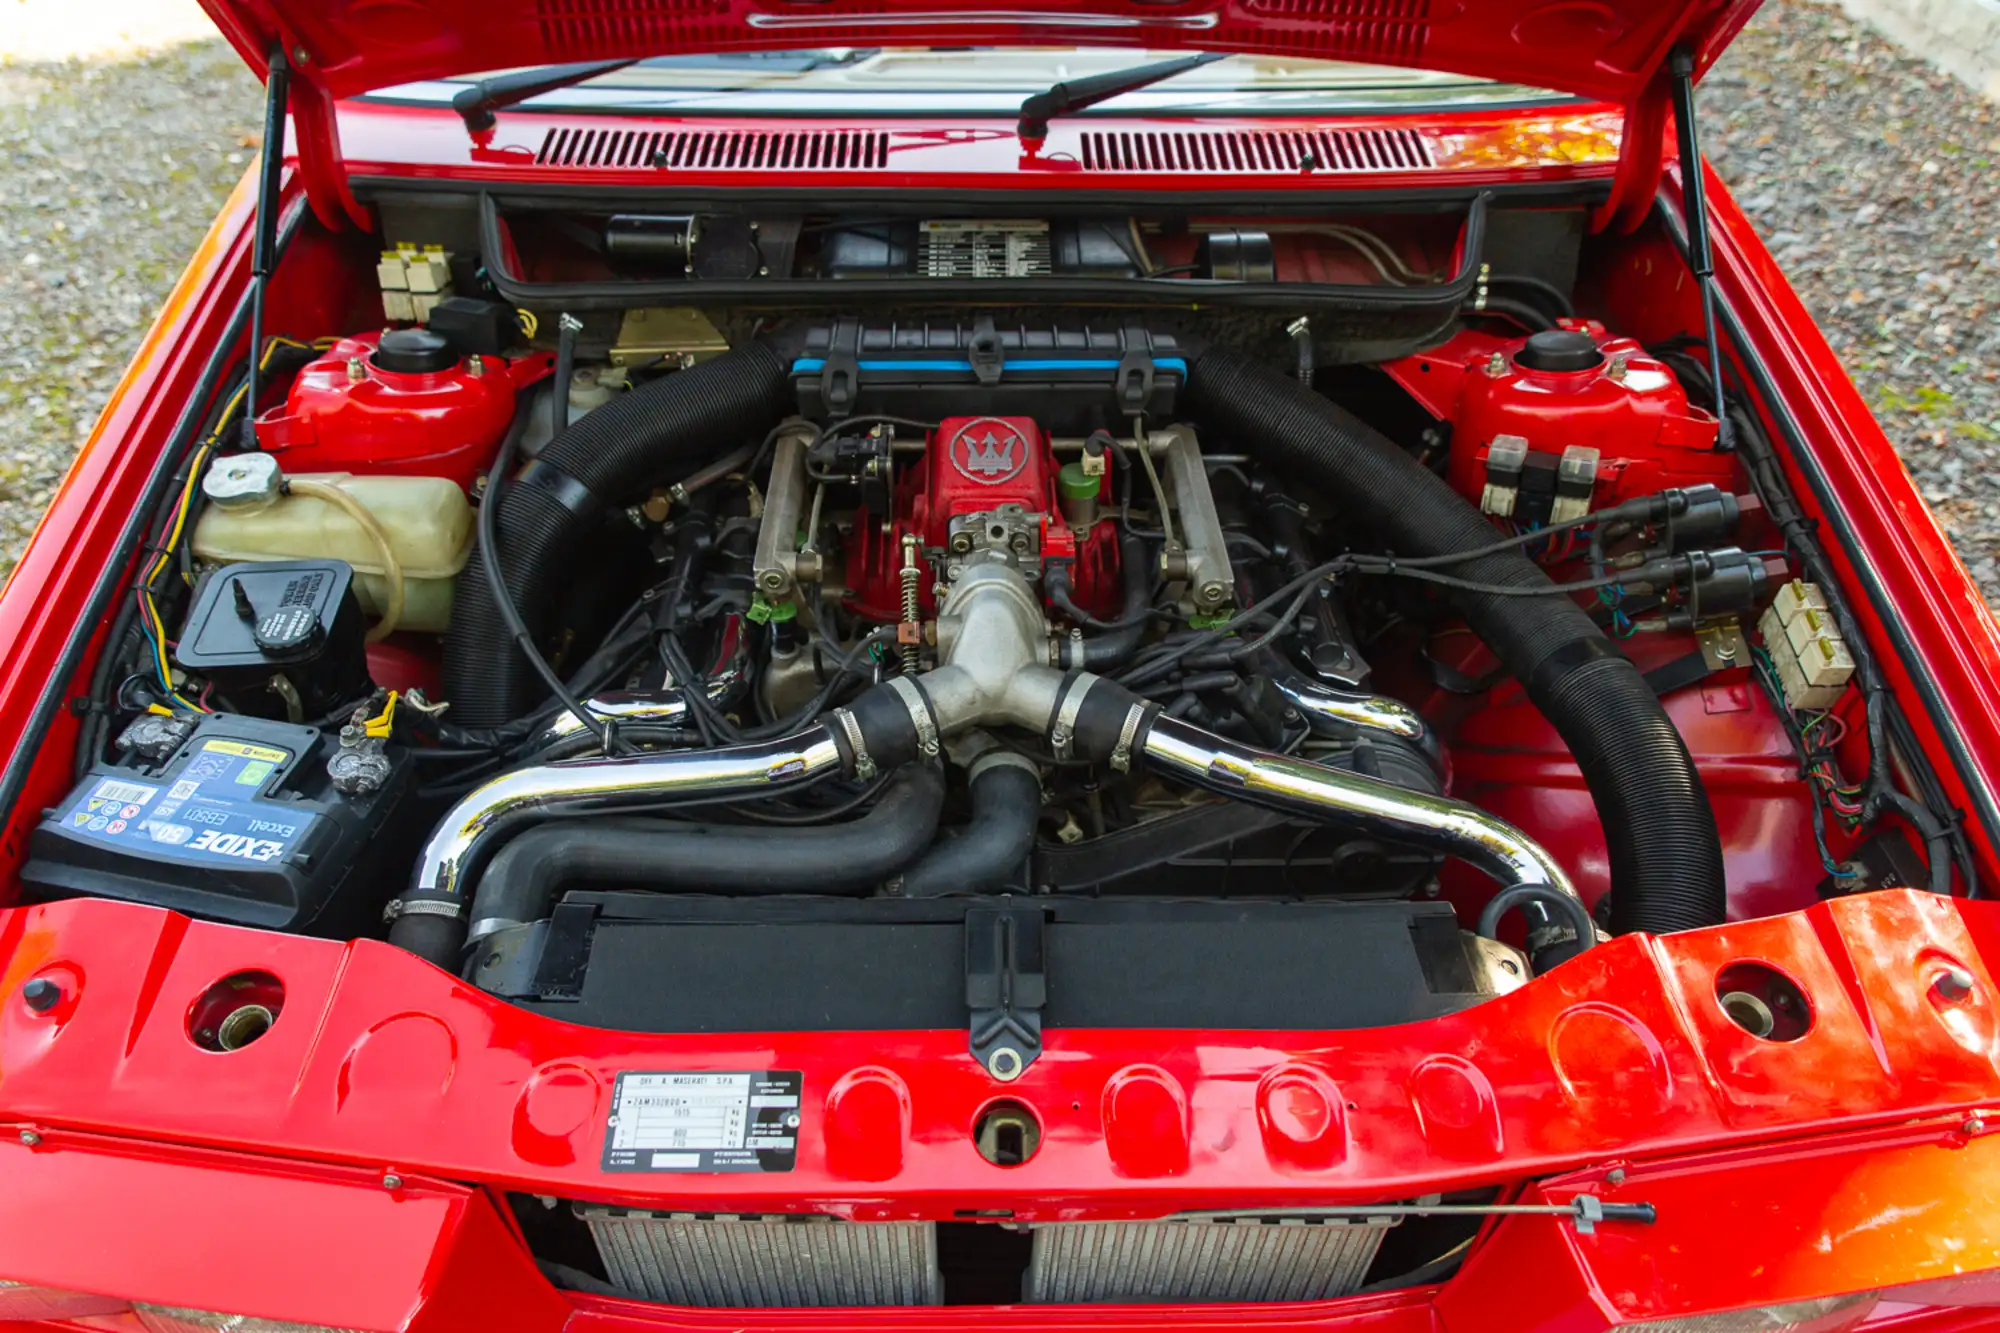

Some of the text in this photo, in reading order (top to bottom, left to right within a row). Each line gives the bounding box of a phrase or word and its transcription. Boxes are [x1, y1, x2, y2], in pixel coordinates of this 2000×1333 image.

[183, 808, 229, 826] EB501
[156, 825, 186, 842] 50
[246, 819, 297, 838] Excell
[190, 829, 285, 862] EXIDE
[673, 1077, 708, 1085] MASERATI
